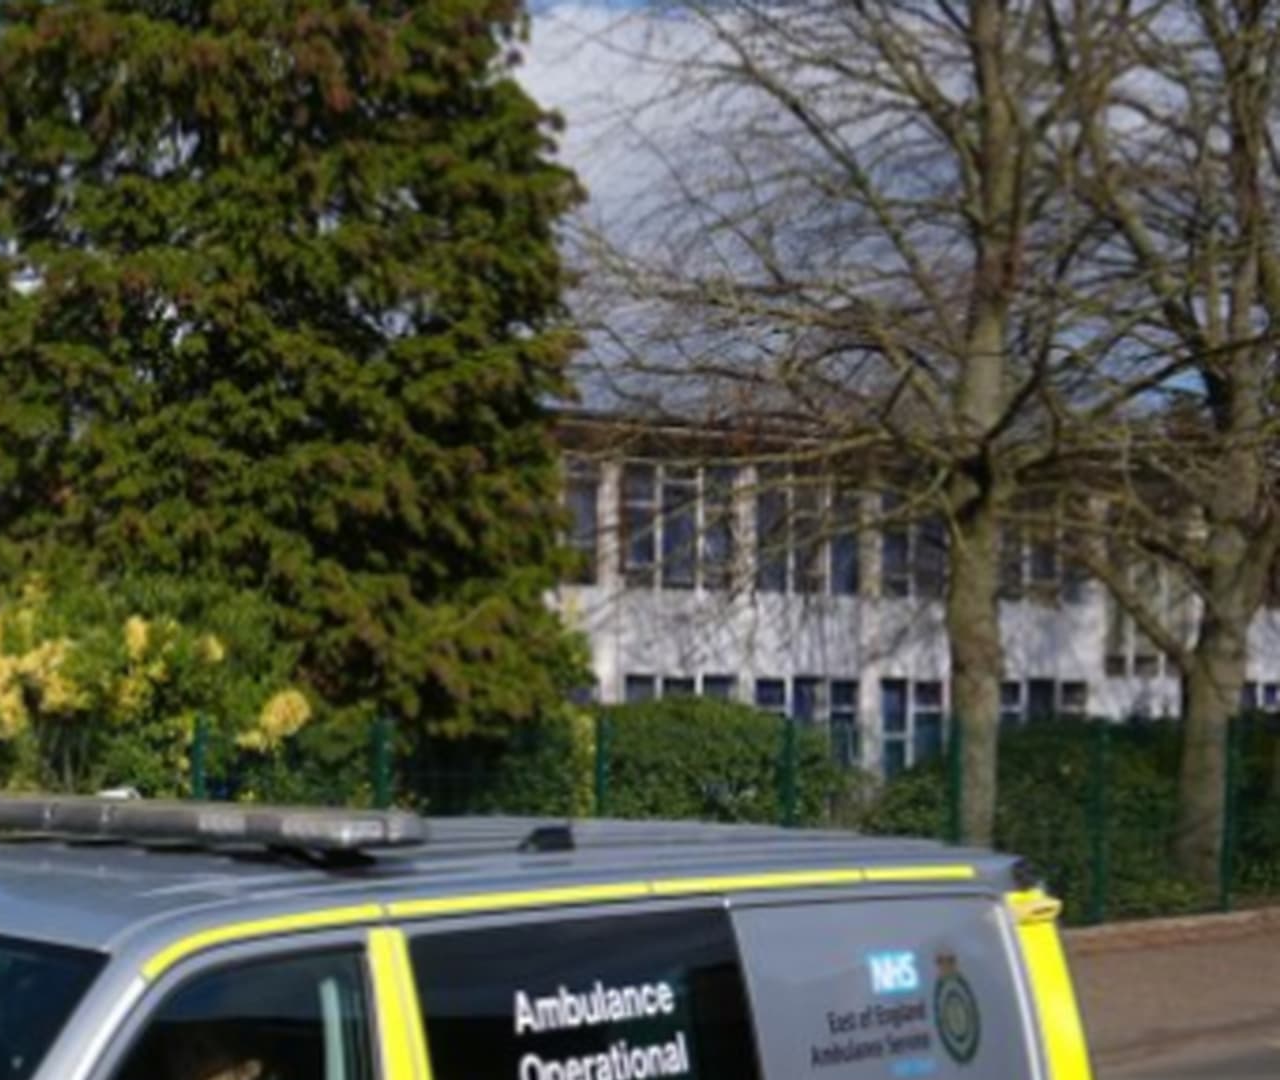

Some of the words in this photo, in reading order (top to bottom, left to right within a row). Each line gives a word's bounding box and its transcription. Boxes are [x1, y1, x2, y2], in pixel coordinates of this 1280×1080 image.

[870, 950, 919, 993] NHS
[514, 979, 676, 1034] Ambulance
[827, 1009, 857, 1035] East
[876, 1001, 927, 1029] England
